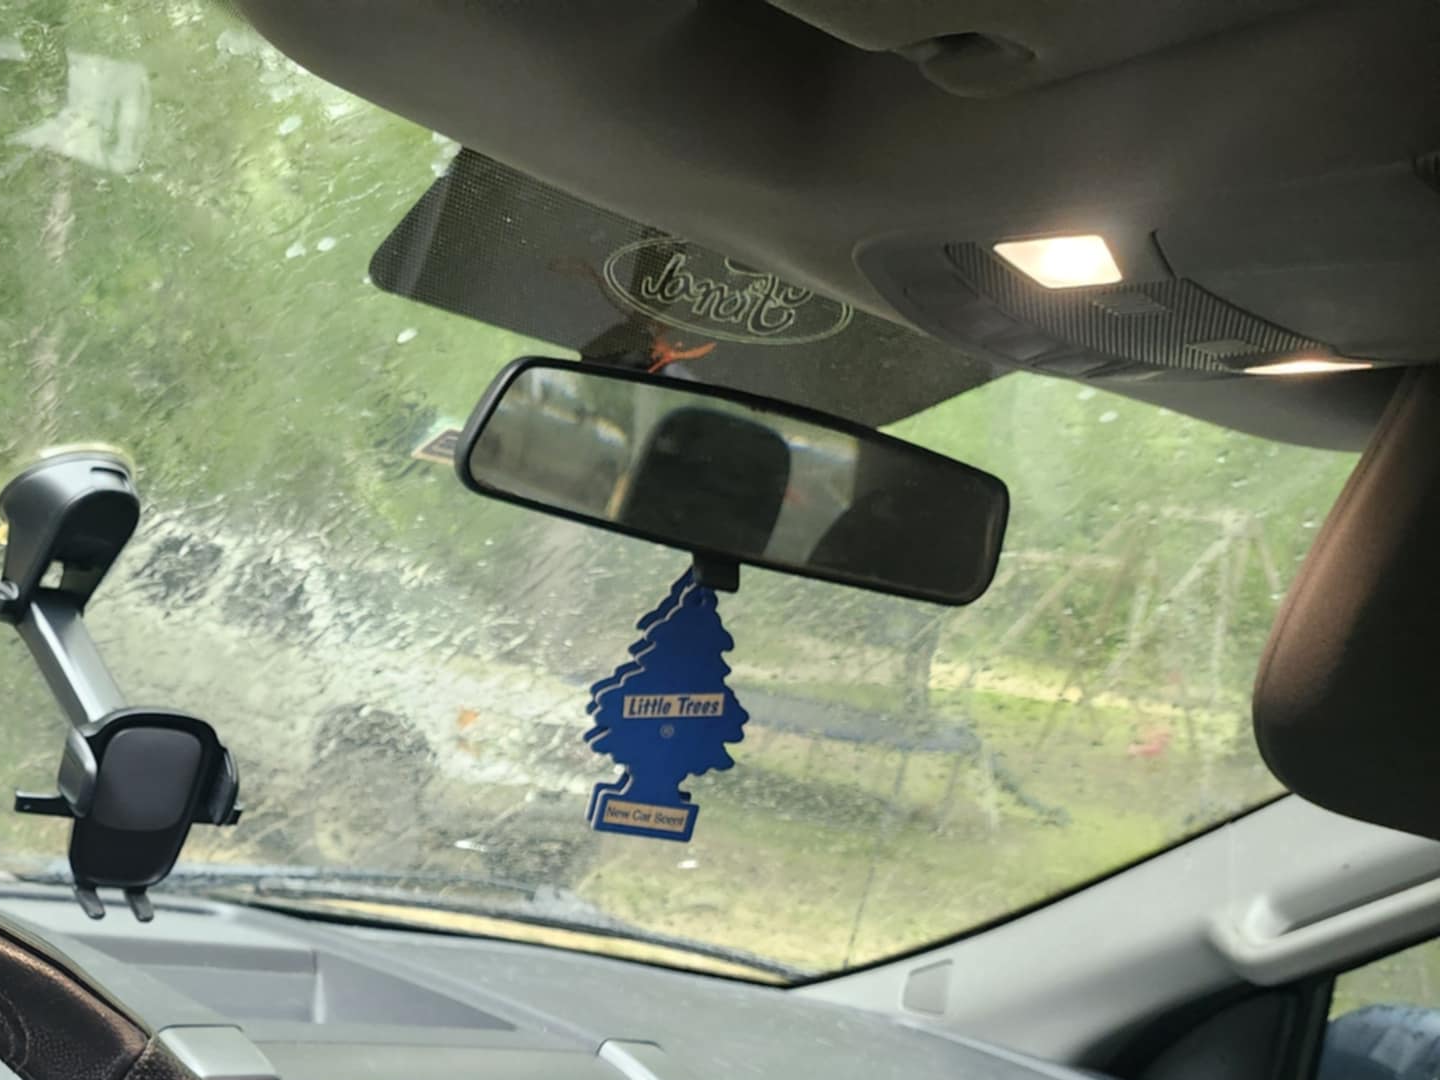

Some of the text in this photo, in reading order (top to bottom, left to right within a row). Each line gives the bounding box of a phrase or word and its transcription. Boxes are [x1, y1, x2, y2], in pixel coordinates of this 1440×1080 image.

[628, 697, 718, 715] Little Trees
[607, 807, 629, 820] New
[633, 809, 651, 821] Car
